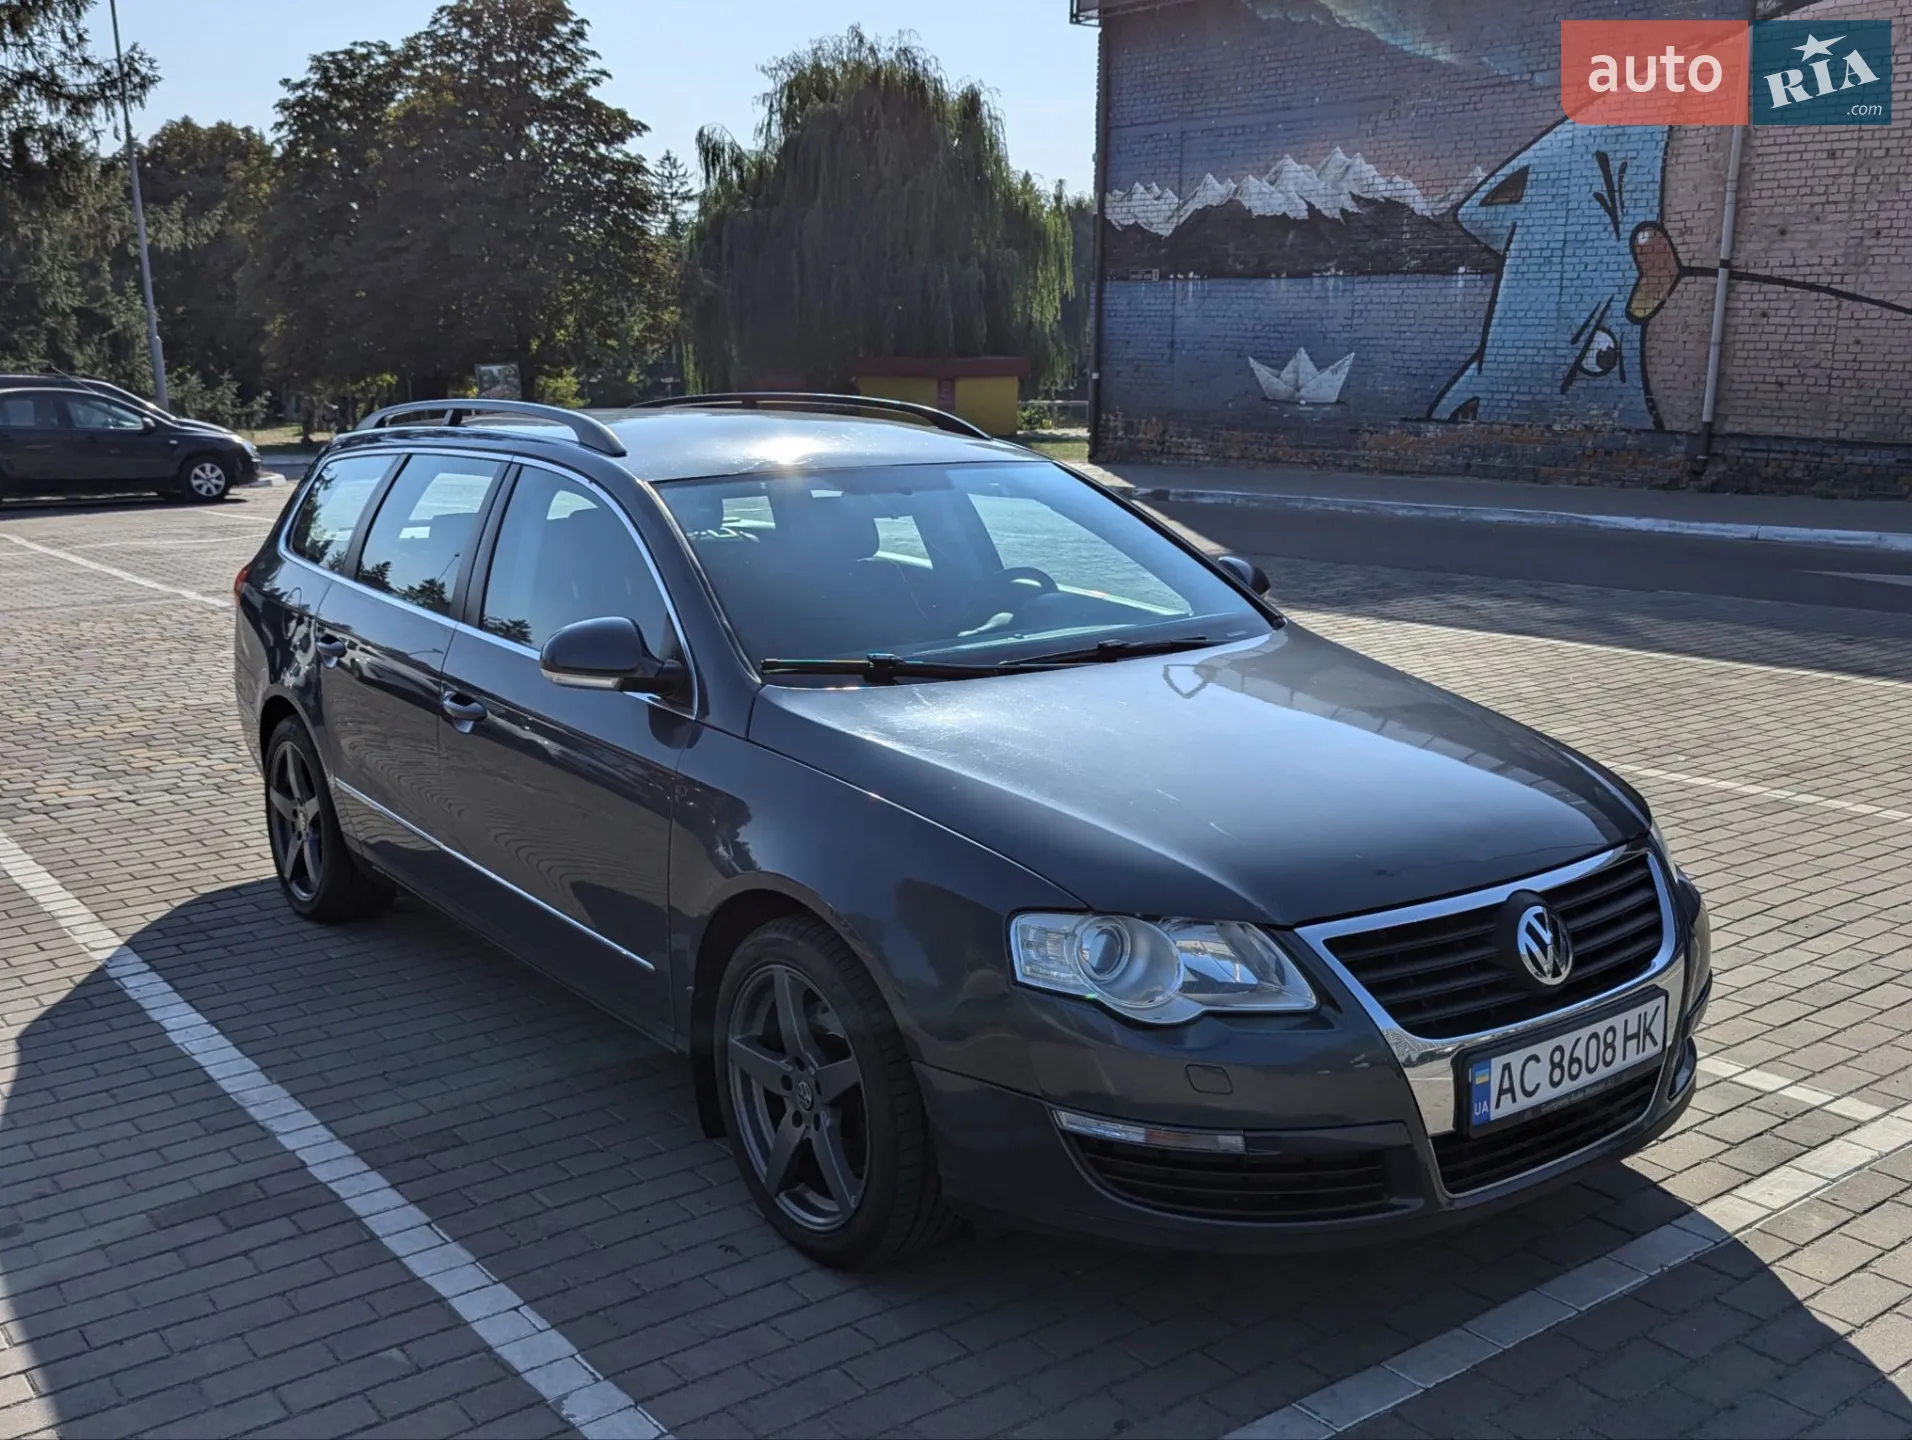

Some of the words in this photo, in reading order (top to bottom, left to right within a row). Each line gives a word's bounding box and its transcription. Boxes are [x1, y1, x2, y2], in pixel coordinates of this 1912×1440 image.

[1494, 1053, 1542, 1111] AC
[1548, 1025, 1617, 1089] 8608
[1622, 1005, 1661, 1061] HK
[1474, 1099, 1489, 1117] UA
